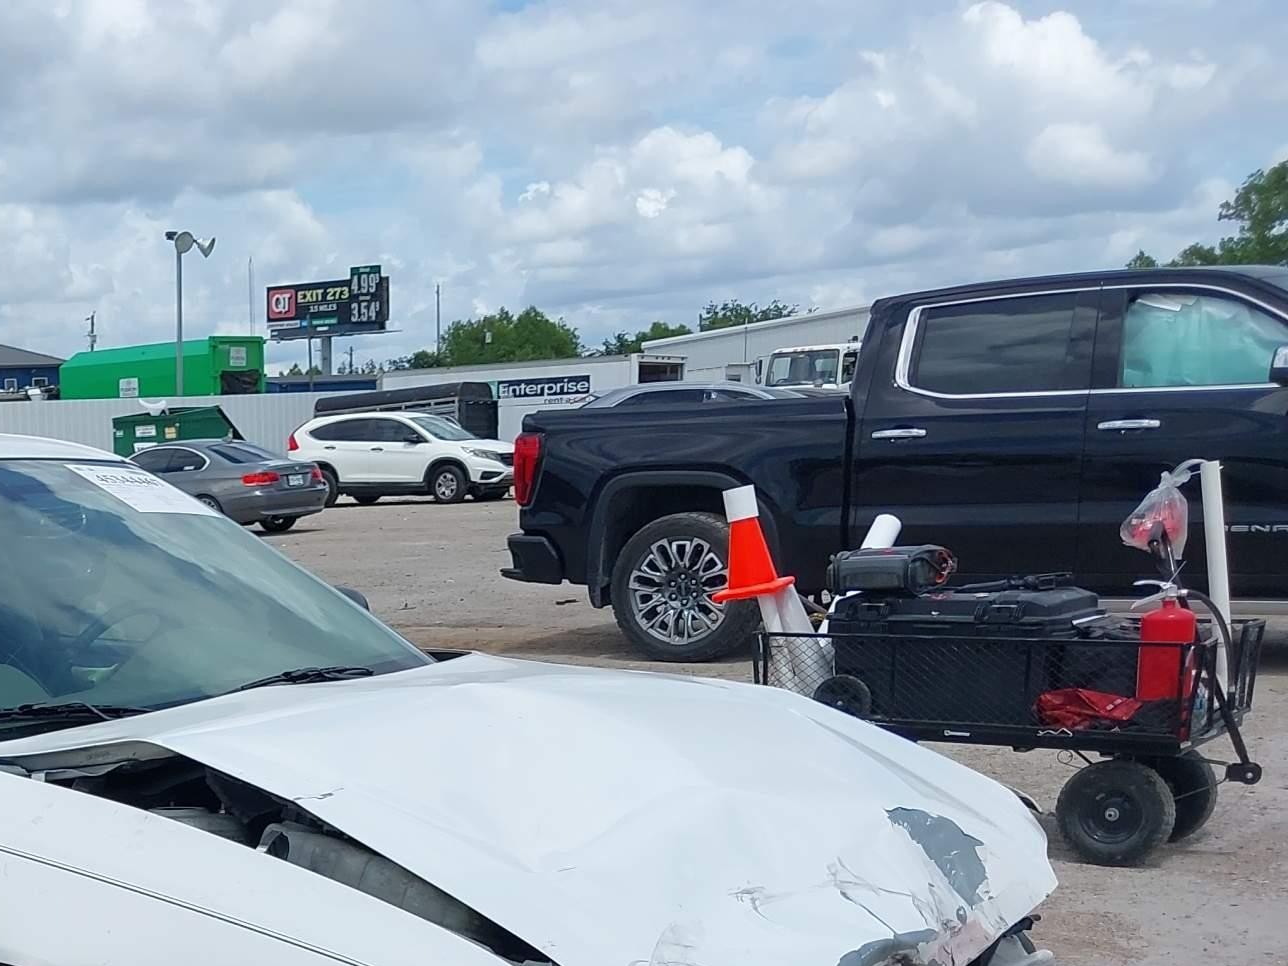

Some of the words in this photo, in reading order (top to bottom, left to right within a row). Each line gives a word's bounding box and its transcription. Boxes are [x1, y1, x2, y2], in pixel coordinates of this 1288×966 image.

[272, 294, 291, 314] QT
[297, 289, 324, 303] EXIT
[326, 286, 350, 300] 273
[498, 378, 589, 397] Enterprise
